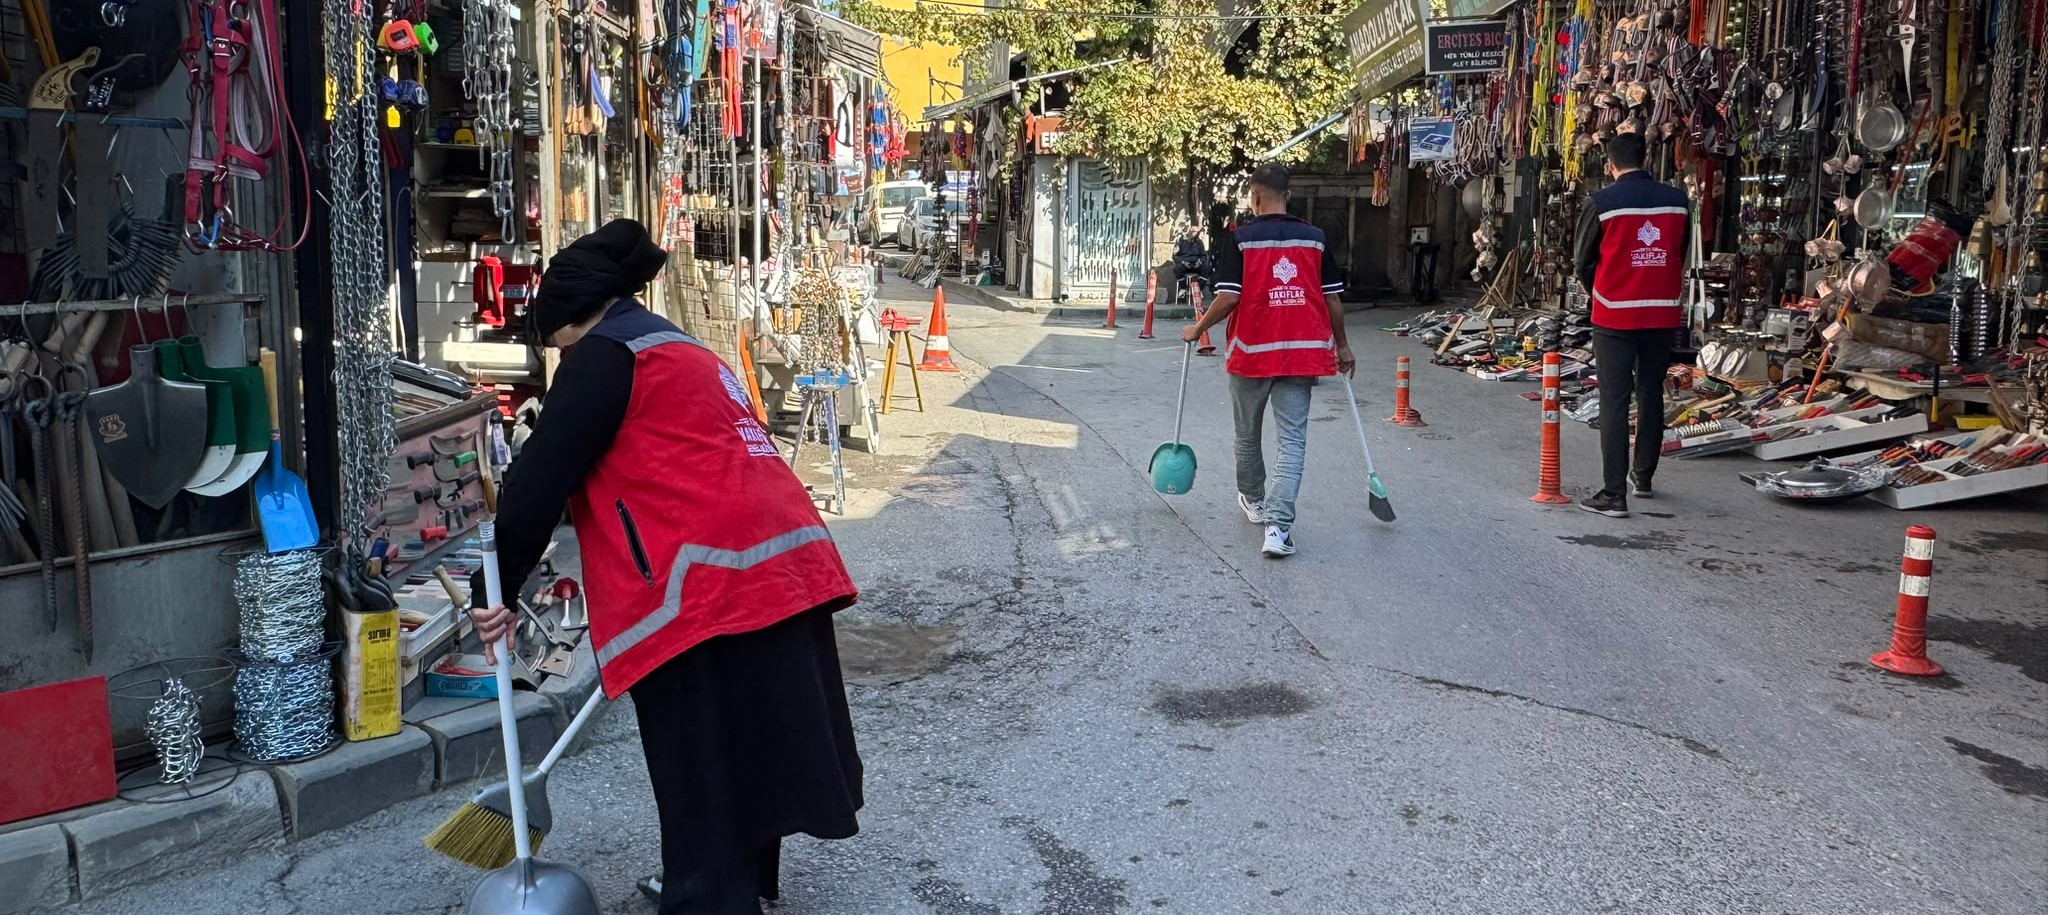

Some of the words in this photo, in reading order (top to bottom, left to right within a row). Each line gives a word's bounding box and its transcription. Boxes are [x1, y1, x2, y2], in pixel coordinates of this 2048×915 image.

[1349, 11, 1386, 61] ANADOLU
[1384, 0, 1416, 39] BIÇAK
[1459, 50, 1480, 59] TÜRLÜ
[1268, 290, 1305, 299] VAKIFLAR
